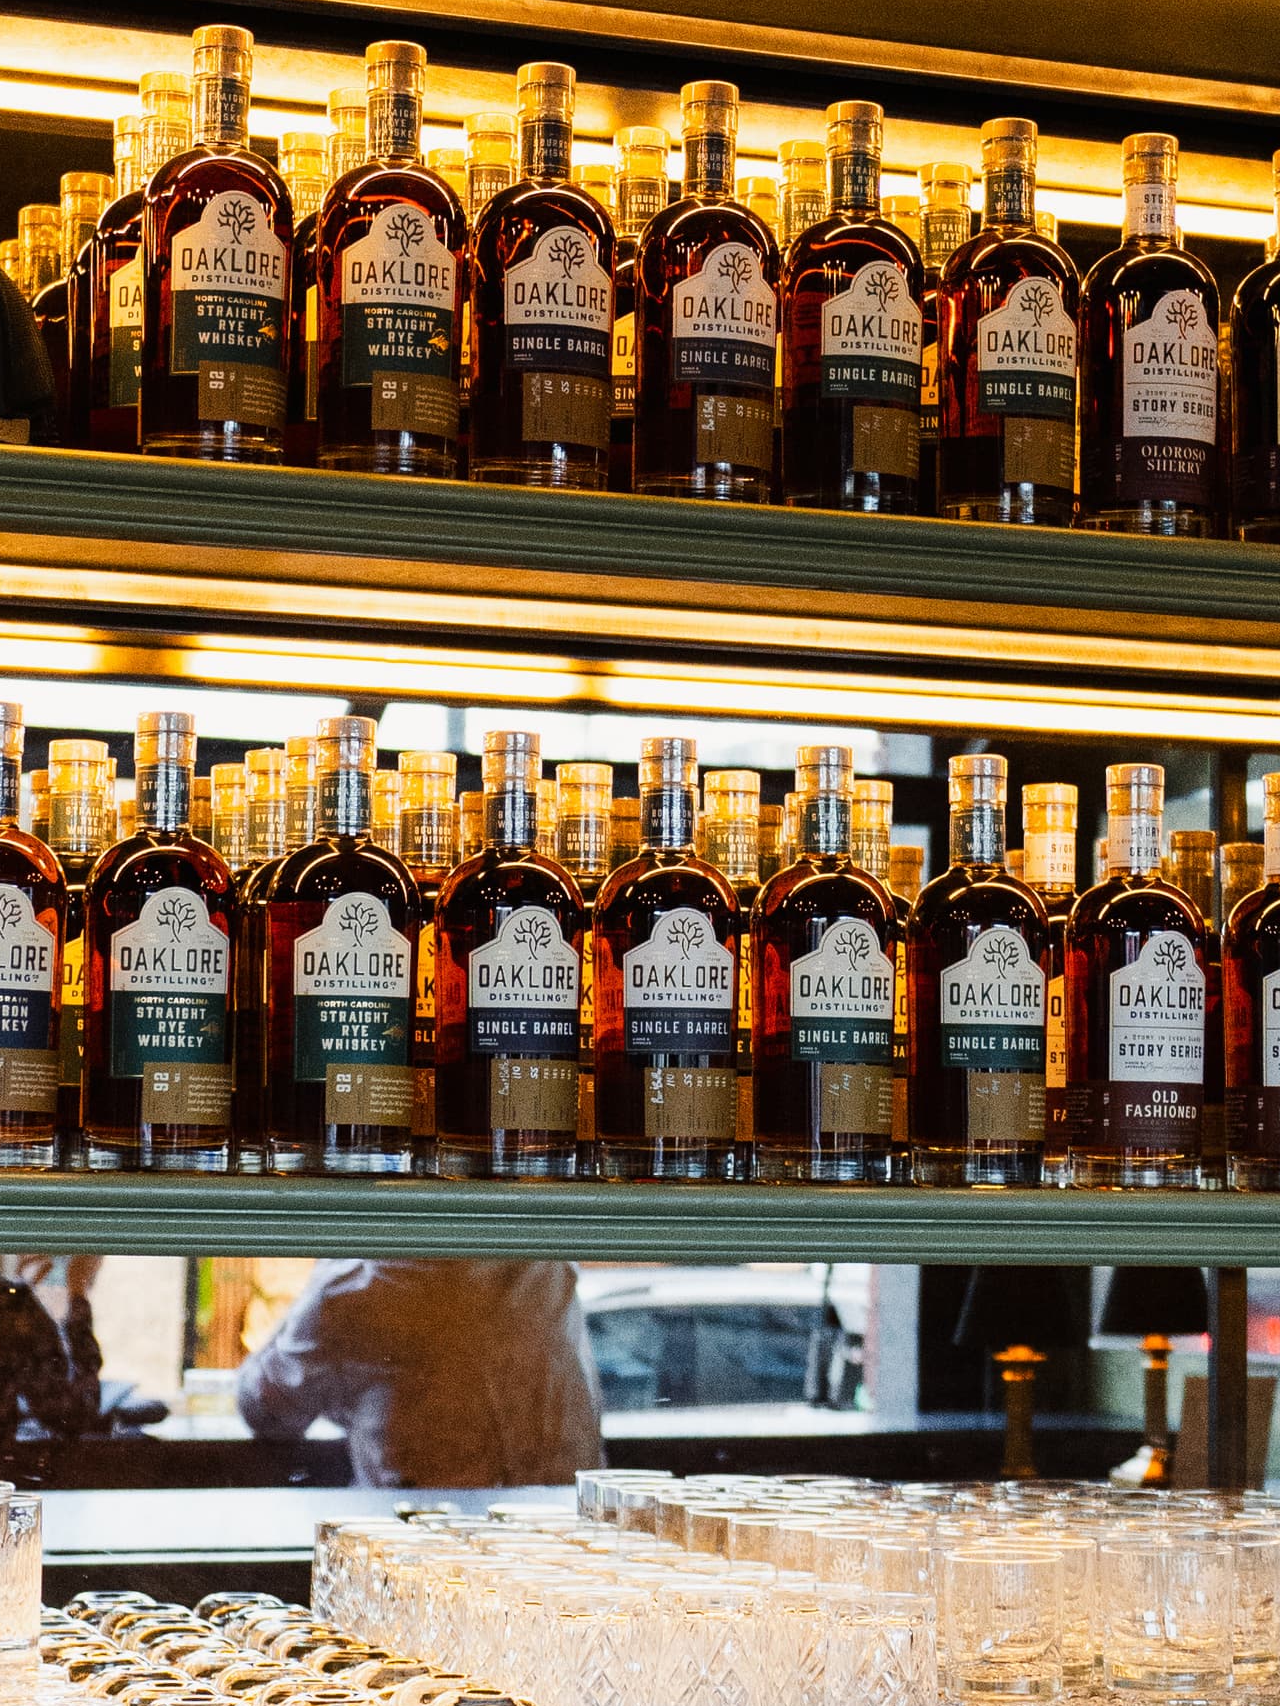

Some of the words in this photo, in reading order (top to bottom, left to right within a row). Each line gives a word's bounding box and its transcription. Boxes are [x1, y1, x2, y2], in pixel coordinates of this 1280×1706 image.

[181, 248, 280, 279] OAKLORE
[192, 274, 264, 288] DISTILLING
[351, 261, 449, 291] OAKLORE
[194, 295, 224, 304] NORTH
[227, 297, 267, 307] CAROLINA
[514, 282, 607, 312] OAKLORE
[197, 305, 264, 322] STRAIGHT
[524, 309, 594, 322] DISTILLING
[683, 296, 772, 328] OAKLORE
[218, 320, 244, 332] RYE
[367, 318, 434, 333] STRAIGHT
[831, 315, 918, 346] OAKLORE
[198, 332, 262, 347] WHISKEY
[387, 331, 414, 344] RYE
[987, 330, 1072, 360] OAKLORE
[368, 345, 431, 359] WHISKEY
[513, 336, 560, 352] SINGLE
[566, 340, 605, 358] BARREL
[680, 350, 727, 364] SINGLE
[734, 354, 771, 372] BARREL
[1133, 342, 1215, 372] OAKLORE
[829, 367, 876, 382] SINGLE
[881, 370, 917, 389] BARREL
[1143, 367, 1208, 380] DISTILLING
[986, 382, 1032, 396] SINGLE
[1037, 385, 1072, 401] BARREL
[1132, 399, 1177, 414] STORY
[1182, 403, 1215, 418] SERIES
[1141, 446, 1206, 462] OLOROSO
[1147, 460, 1201, 475] SHERRY
[120, 947, 222, 974] OAKLORE
[303, 952, 404, 978] OAKLORE
[130, 975, 207, 986] DISTILLING
[479, 965, 574, 991] OAKLORE
[633, 966, 728, 991] OAKLORE
[800, 975, 890, 1001] OAKLORE
[950, 982, 1040, 1008] OAKLORE
[167, 997, 209, 1005] CAROLINA
[490, 993, 562, 1003] DISTILLING
[1120, 985, 1203, 1011] OAKLORE
[136, 1007, 206, 1021] STRAIGHT
[320, 1012, 389, 1024] STRAIGHT
[1130, 1011, 1194, 1021] DISTILLING
[158, 1022, 186, 1034] RYE
[341, 1024, 369, 1037] RYE
[477, 1022, 527, 1034] SINGLE
[533, 1022, 574, 1036] BARREL
[632, 1022, 680, 1034] SINGLE
[687, 1022, 729, 1036] BARREL
[138, 1034, 203, 1048] WHISKEY
[321, 1038, 385, 1051] WHISKEY
[798, 1029, 847, 1044] SINGLE
[853, 1030, 889, 1045] BARREL
[949, 1036, 995, 1050] SINGLE
[1002, 1037, 1040, 1052] BARREL
[1119, 1043, 1164, 1057] STORY
[1170, 1044, 1202, 1059] SERIES
[1152, 1090, 1178, 1104] OLD
[1125, 1104, 1197, 1118] FASHIONED
